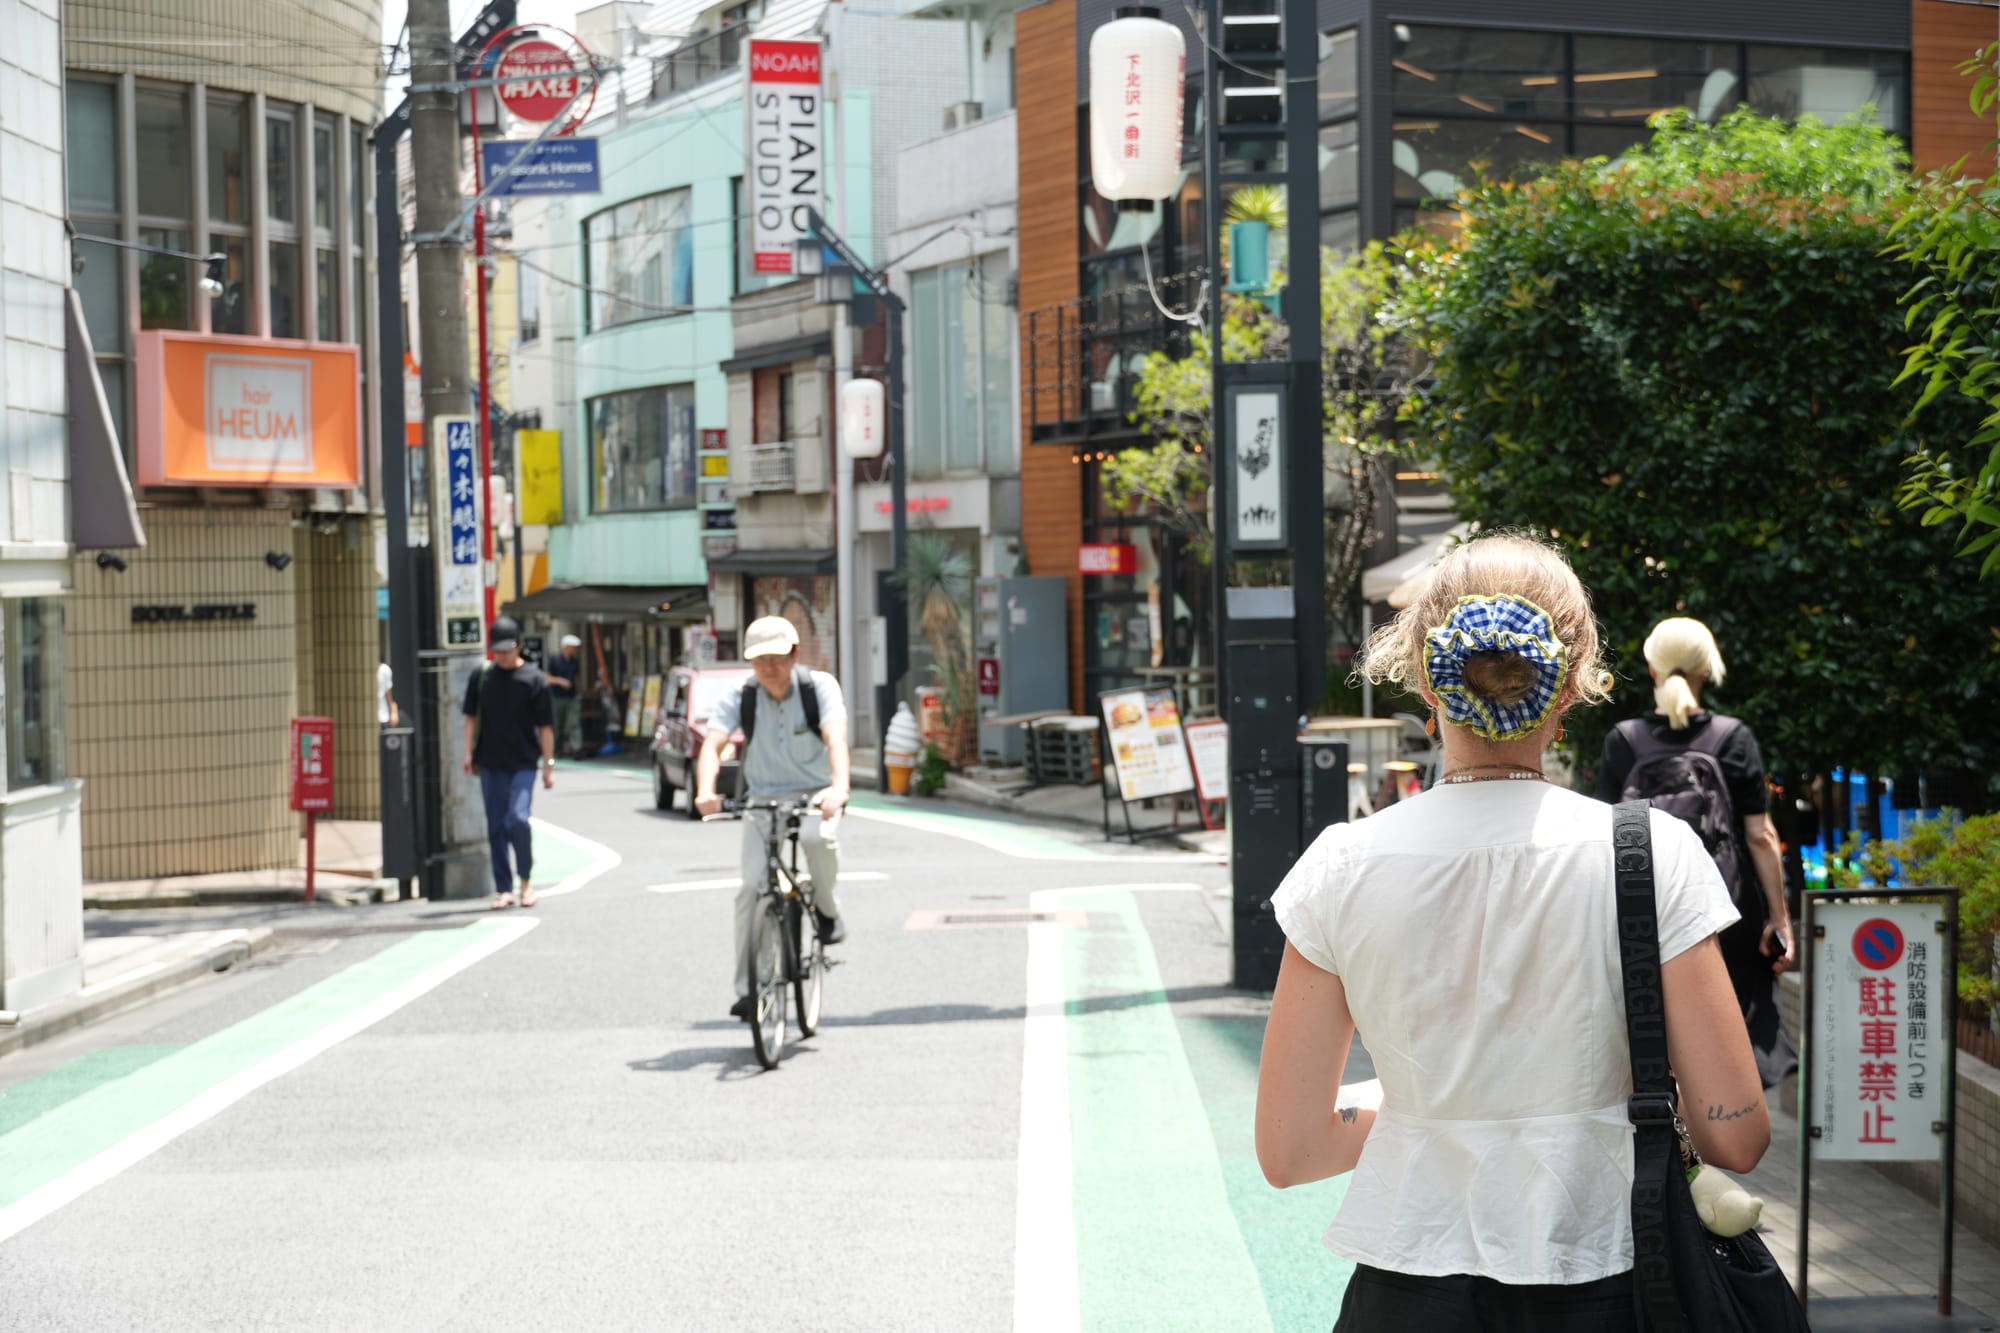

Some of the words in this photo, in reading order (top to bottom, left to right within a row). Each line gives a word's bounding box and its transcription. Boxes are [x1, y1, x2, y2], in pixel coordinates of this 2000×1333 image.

[753, 53, 818, 73] NOAH
[1124, 53, 1142, 159] 下北沢一番街
[490, 161, 549, 177] Paasonic
[551, 160, 593, 175] Homes
[756, 92, 783, 232] STUDIO
[789, 94, 817, 233] PIANO
[217, 407, 299, 442] HEUM
[242, 382, 273, 406] hair
[449, 422, 477, 563] 佐々木眼科
[1622, 914, 1664, 1039] BAGGU
[1906, 941, 1927, 1100] 消防設備前につき
[1857, 976, 1897, 1145] 駐車禁止
